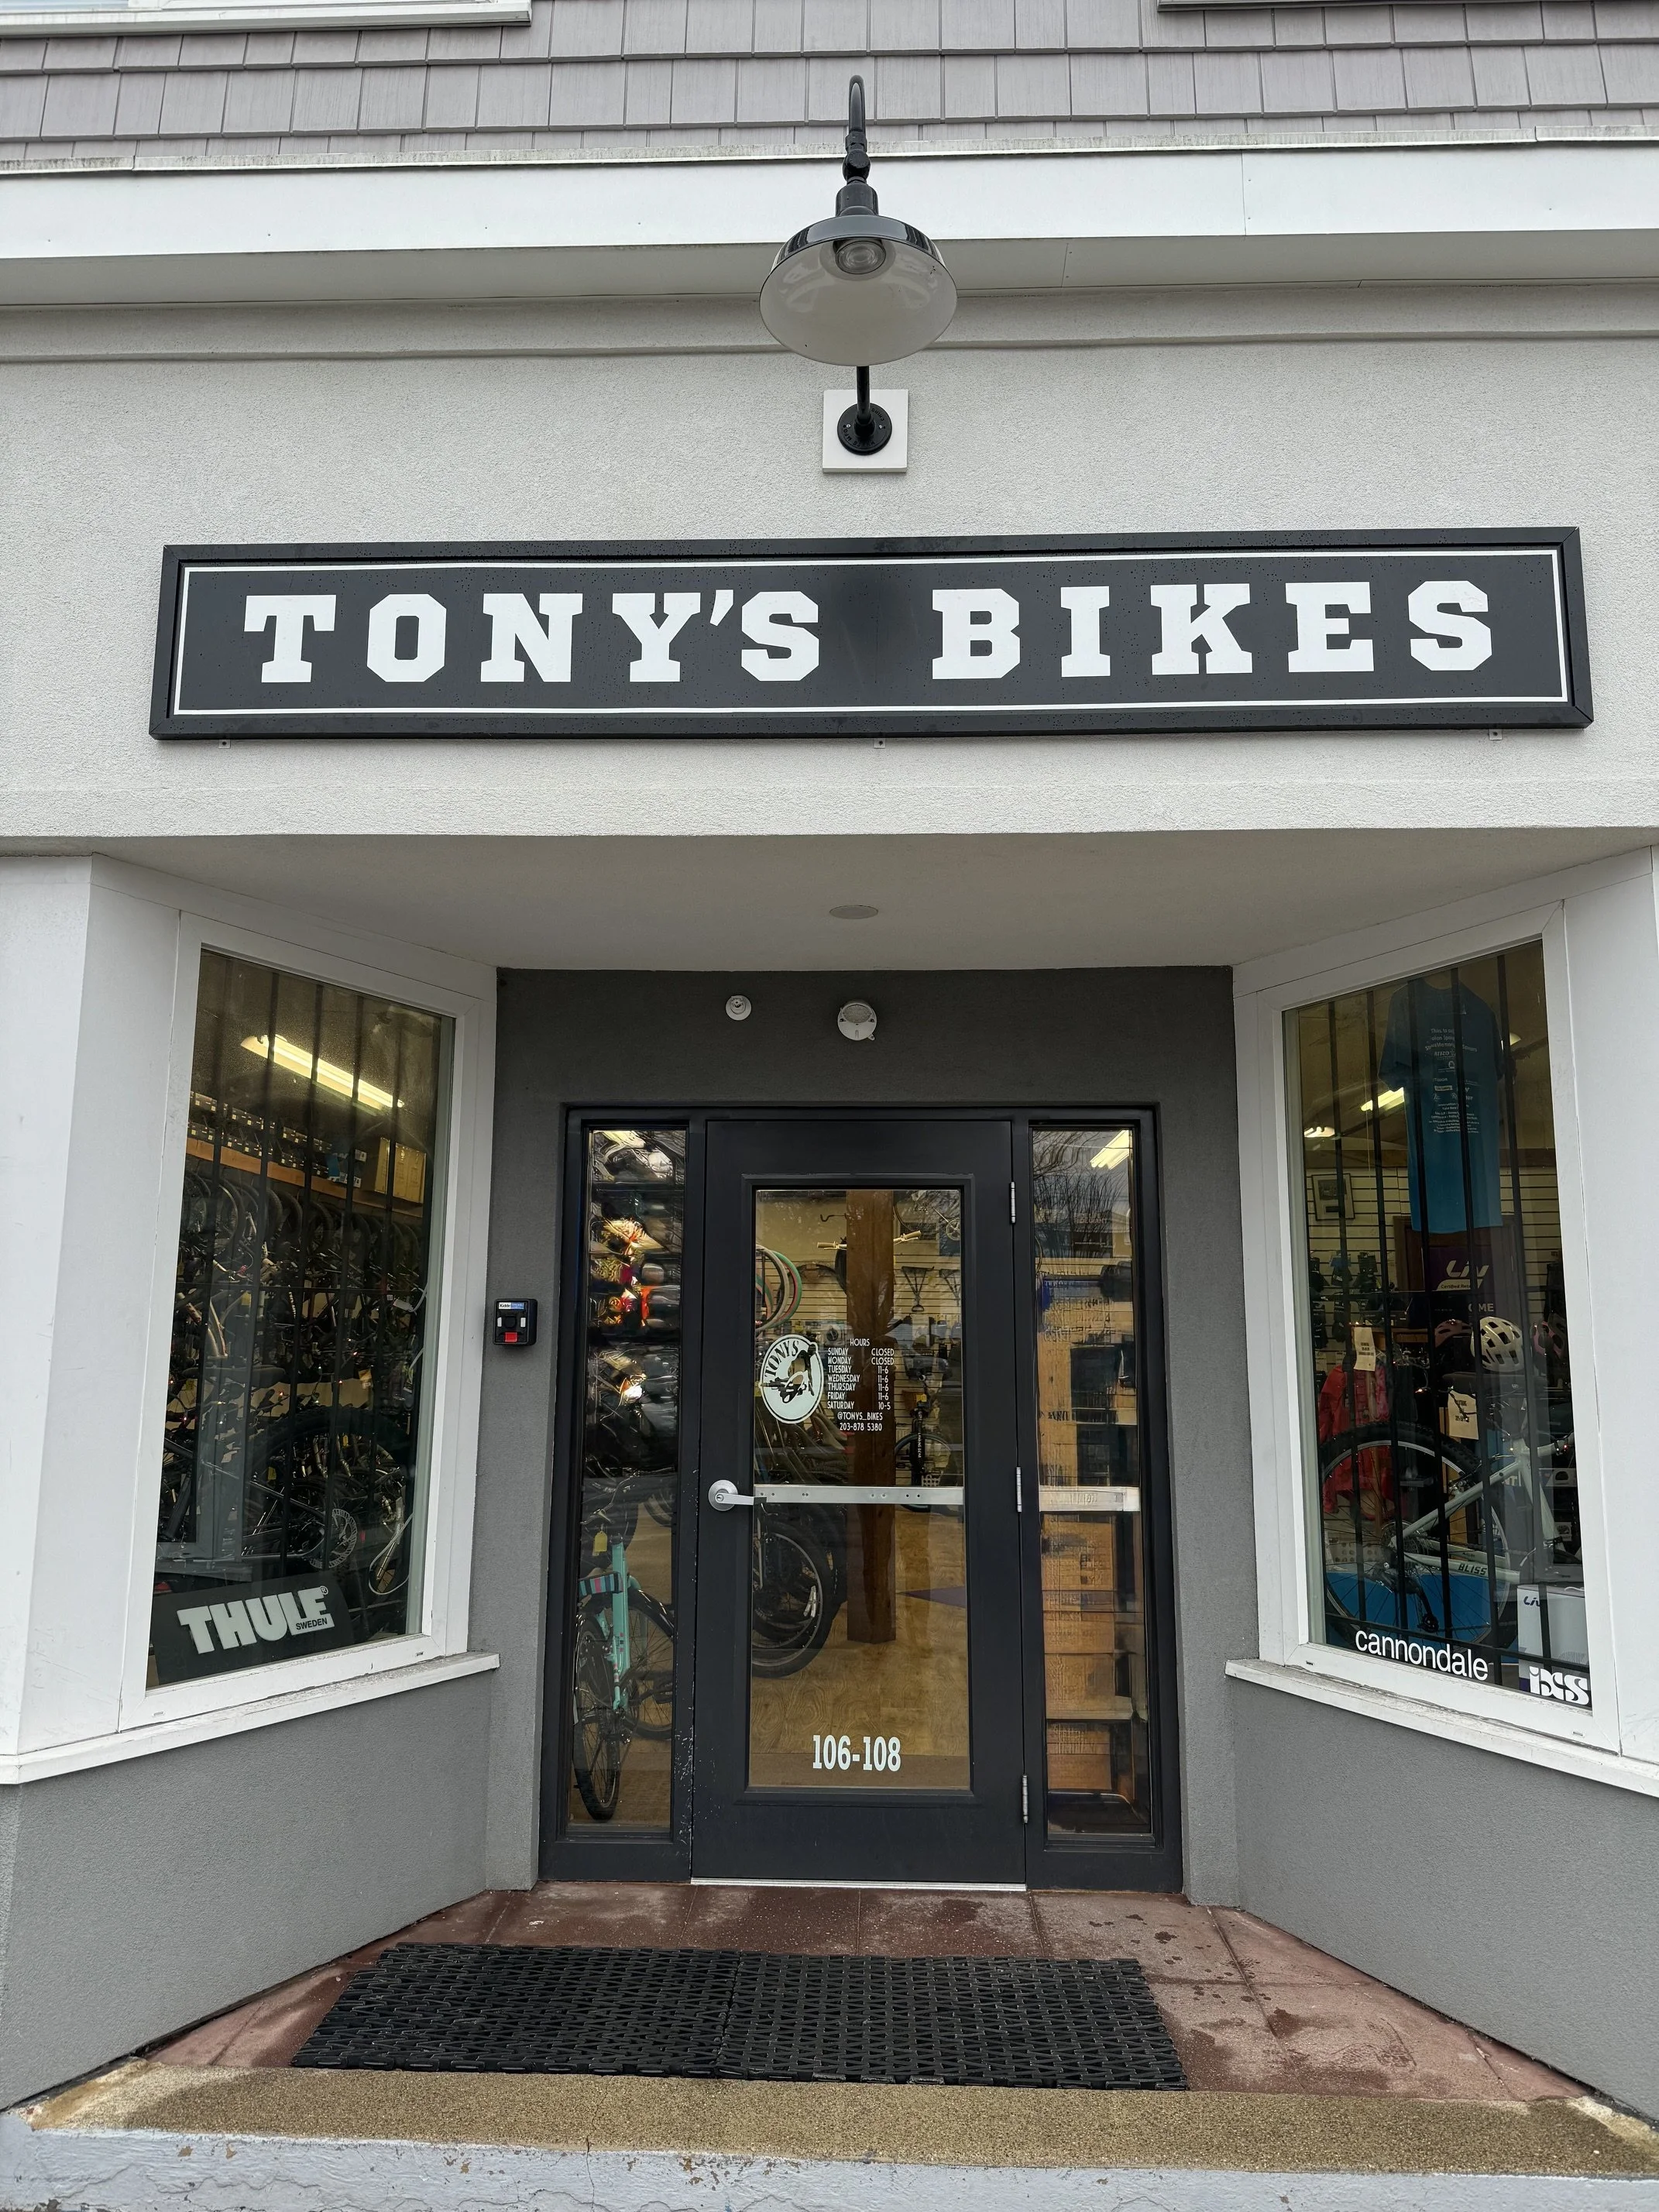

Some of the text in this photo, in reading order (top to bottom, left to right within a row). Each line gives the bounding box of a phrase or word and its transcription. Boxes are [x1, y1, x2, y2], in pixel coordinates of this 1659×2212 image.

[244, 580, 1492, 683] TONY'S BIKES
[871, 1348, 895, 1356] CLOSED
[878, 1365, 888, 1374] 11-6
[828, 1374, 860, 1382] WEDNESDAY
[828, 1382, 888, 1392] THURSDAY 11-6
[878, 1392, 888, 1400] 11-6
[837, 1411, 883, 1420] @TONYS_BIKES
[840, 1422, 882, 1431] 203-878 5380
[1458, 1562, 1487, 1575] BLISS
[177, 1586, 335, 1654] THULE
[296, 1617, 328, 1630] SWEDEN
[1355, 1630, 1489, 1681] cannondale
[812, 1735, 901, 1771] 106-108
